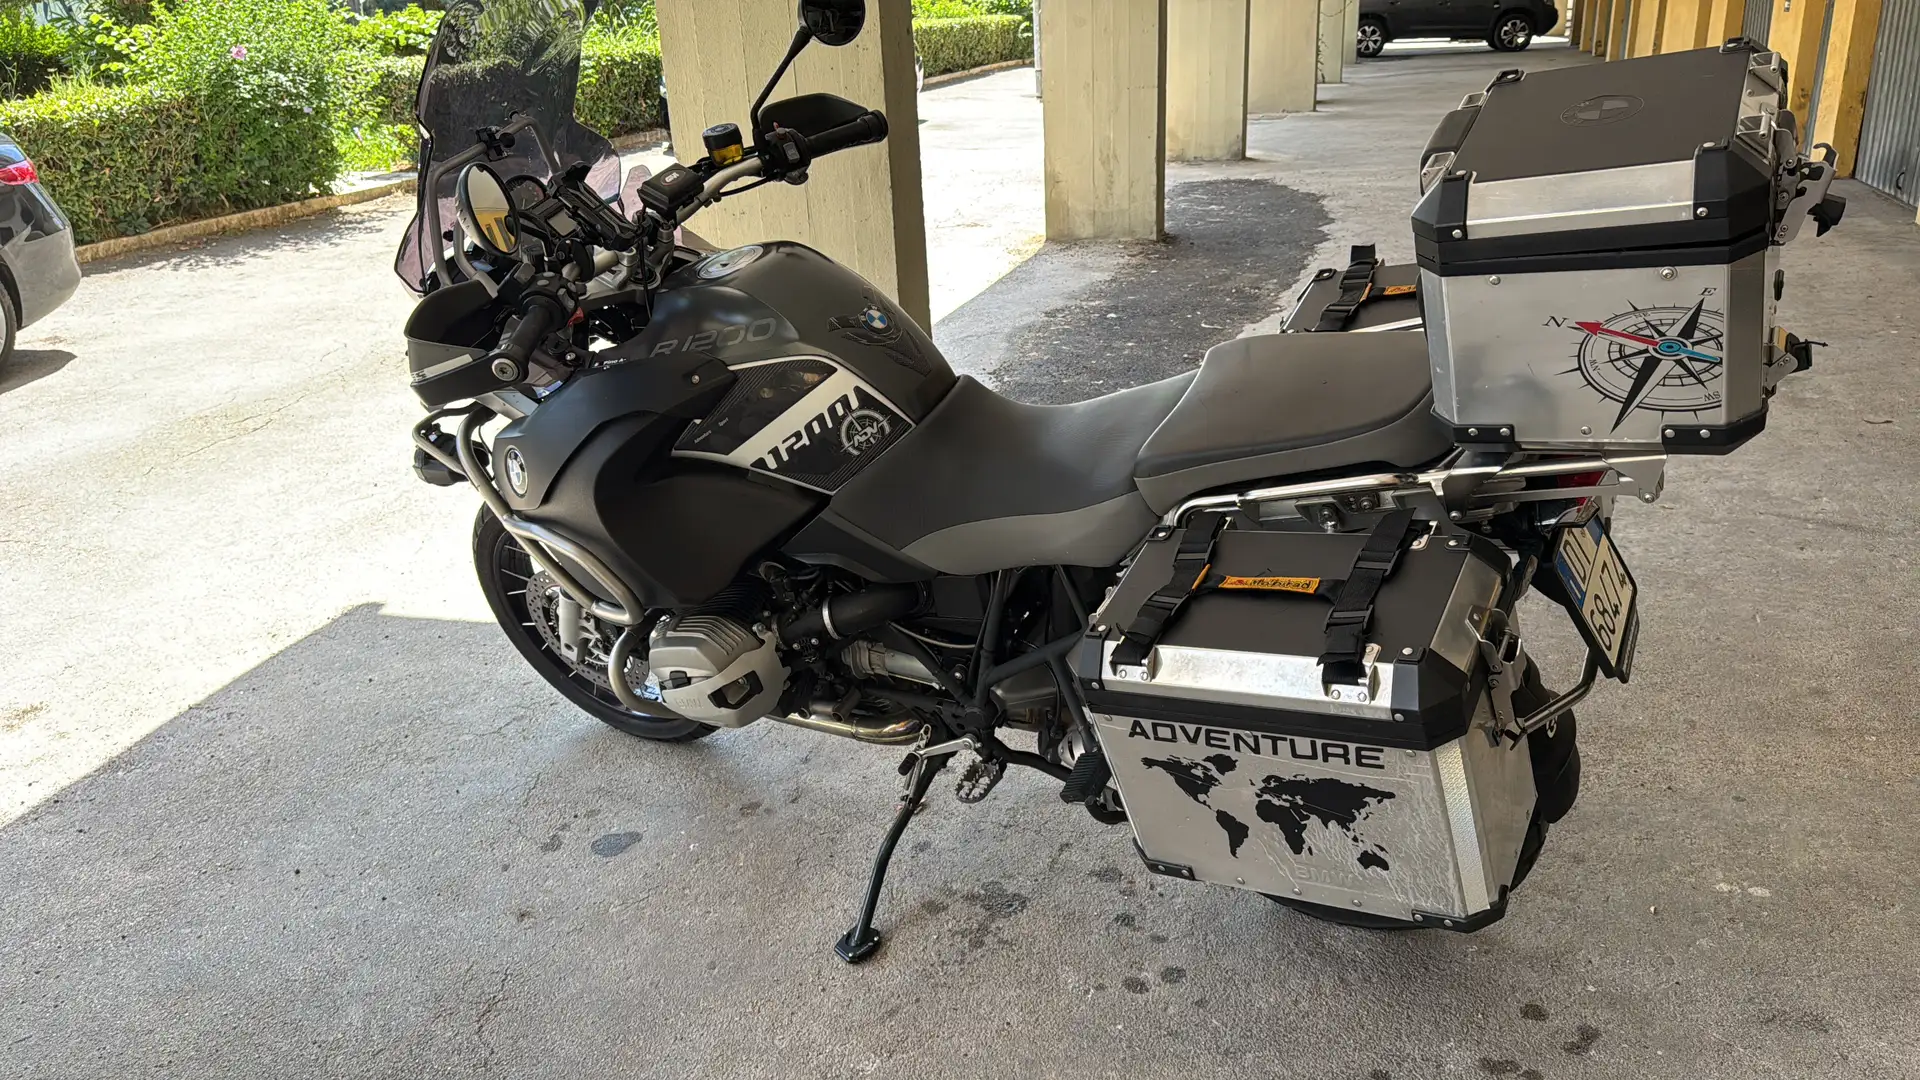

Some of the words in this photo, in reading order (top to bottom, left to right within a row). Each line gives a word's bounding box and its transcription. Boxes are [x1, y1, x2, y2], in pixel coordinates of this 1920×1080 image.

[1698, 287, 1717, 297] E
[1543, 315, 1569, 328] N
[650, 338, 678, 358] R
[681, 317, 777, 353] 1200
[1128, 719, 1386, 770] ADVENTURE
